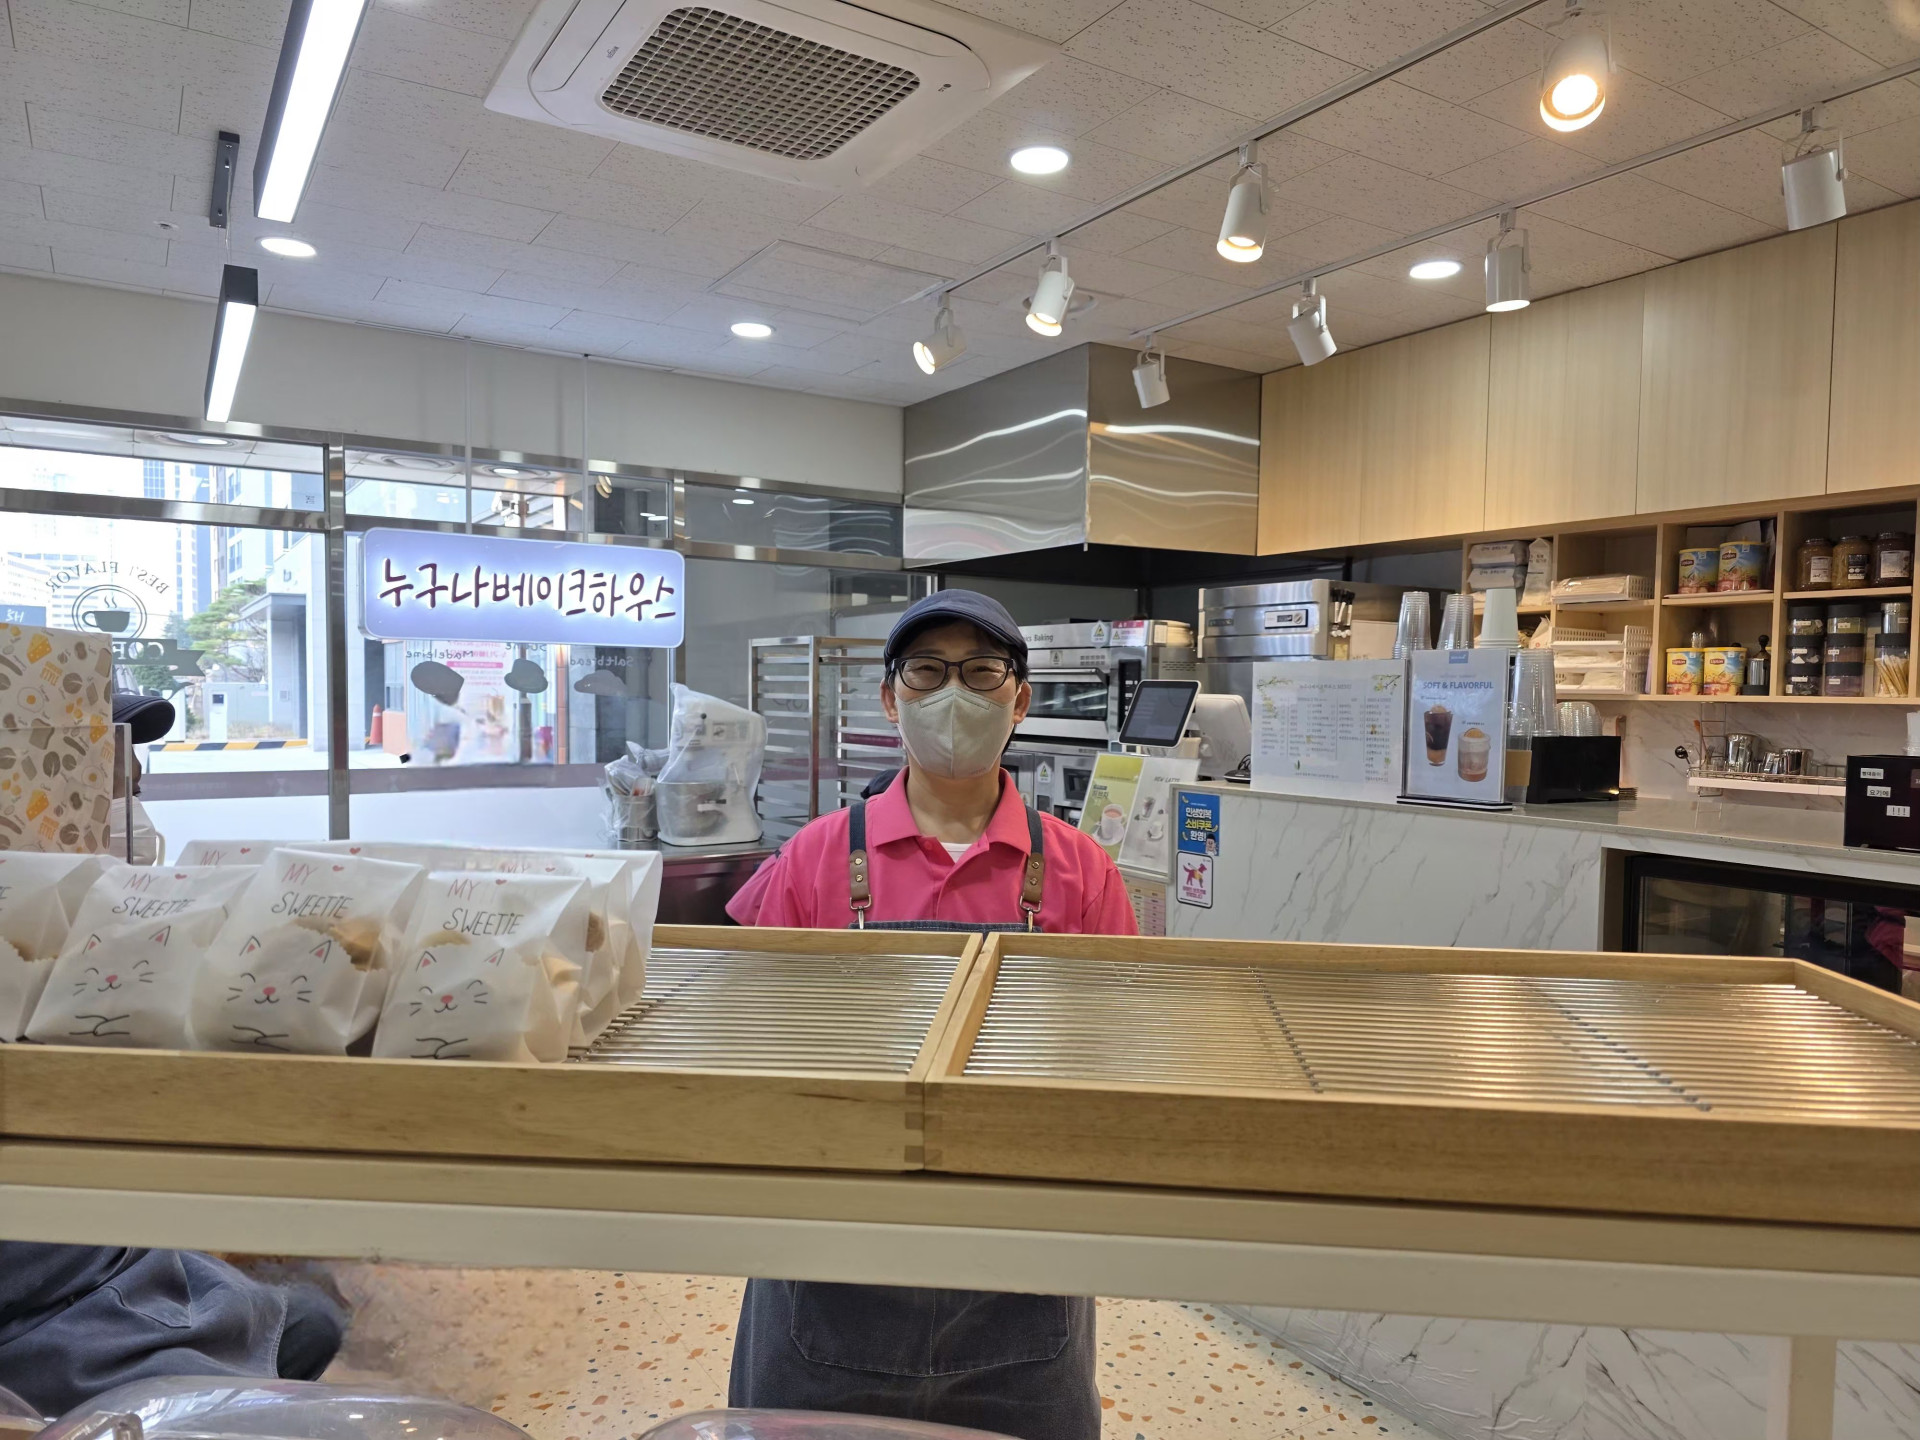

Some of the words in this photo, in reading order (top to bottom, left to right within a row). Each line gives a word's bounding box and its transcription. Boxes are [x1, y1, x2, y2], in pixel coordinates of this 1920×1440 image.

[378, 558, 676, 622] 누구나베이크하우스
[1423, 682, 1441, 690] SOFT
[1449, 681, 1494, 690] FLAVORFUL
[1869, 789, 1889, 797] 요기에
[1185, 807, 1212, 820] 민생회복
[1185, 818, 1213, 831] 소비쿠폰
[1190, 830, 1207, 842] 환영!
[281, 863, 320, 886] MY
[122, 873, 161, 893] MY
[447, 878, 482, 901] MY
